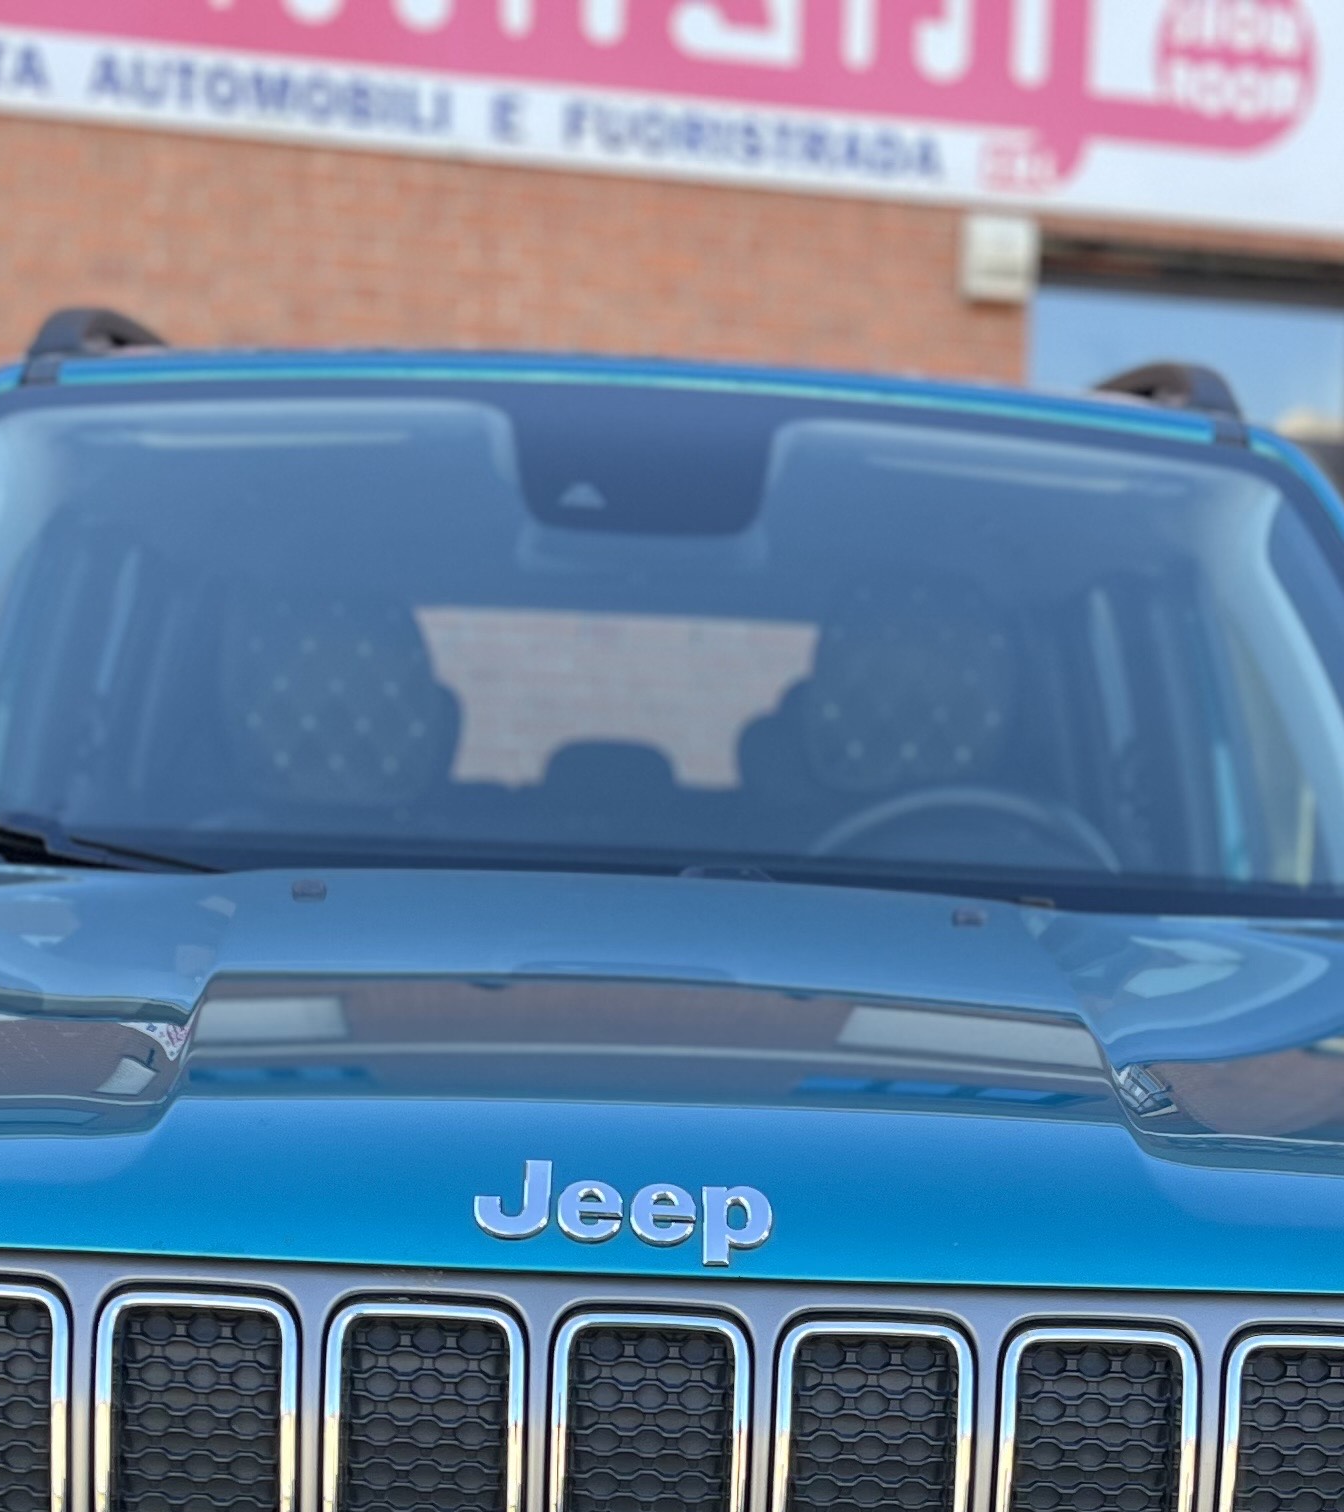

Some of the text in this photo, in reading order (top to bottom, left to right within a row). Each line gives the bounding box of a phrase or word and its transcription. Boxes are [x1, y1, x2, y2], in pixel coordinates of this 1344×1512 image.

[89, 54, 451, 132] AUTOMOBILI
[488, 94, 524, 146] E
[565, 103, 943, 180] FUORISTRADA
[473, 1160, 772, 1266] Jeep
